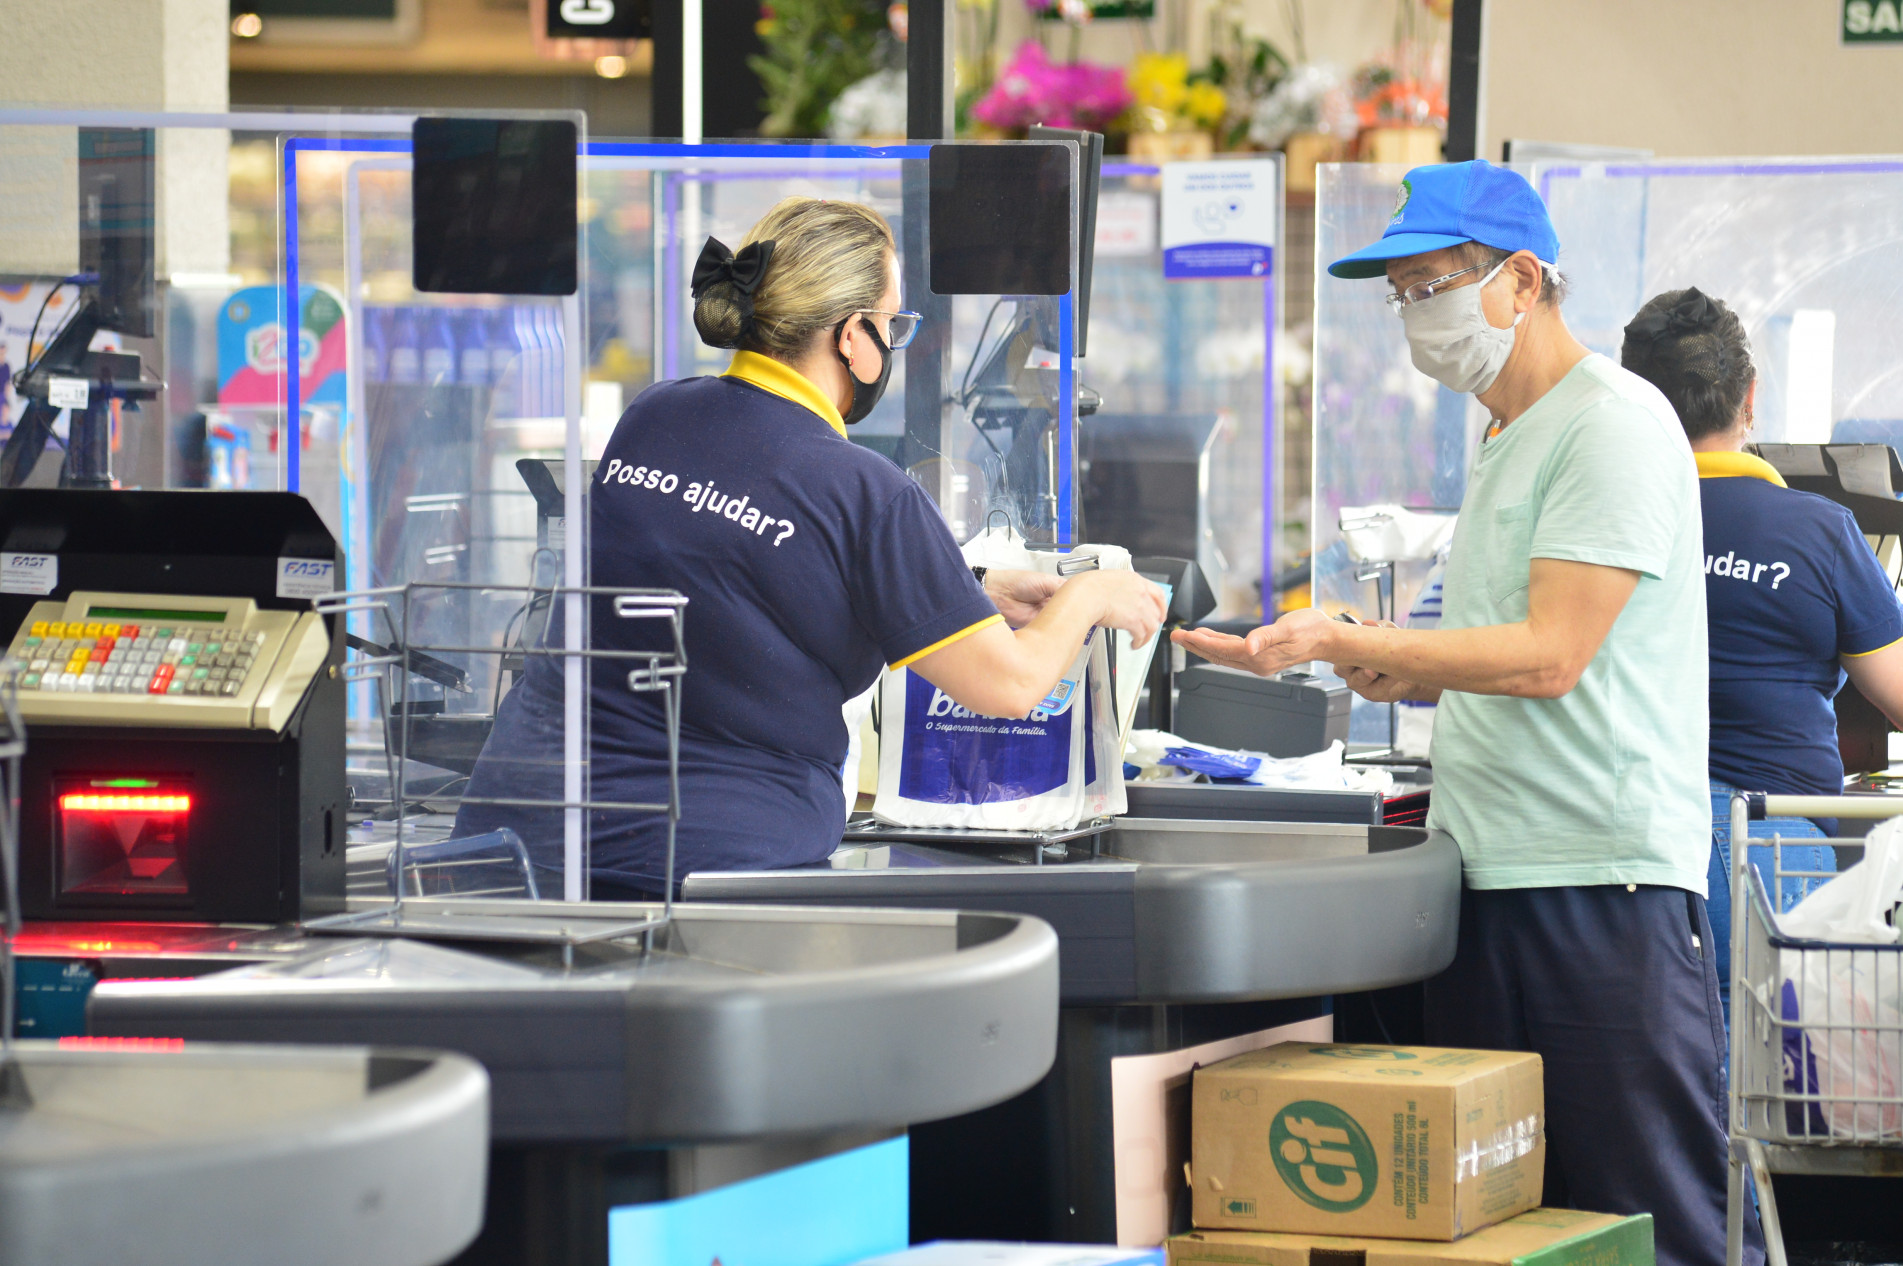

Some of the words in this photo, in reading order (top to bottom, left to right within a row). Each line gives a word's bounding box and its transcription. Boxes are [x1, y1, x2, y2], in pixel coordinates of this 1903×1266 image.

[602, 458, 679, 494] Posso
[682, 480, 795, 547] ajudar?
[11, 555, 48, 567] FAST
[284, 560, 333, 576] FAST
[935, 722, 997, 735] Supermercado
[998, 725, 1010, 735] da
[1406, 1115, 1417, 1131] 500
[1393, 1113, 1404, 1156] UNIDADES
[1418, 1131, 1429, 1156] TOTAL
[1393, 1158, 1404, 1169] 12
